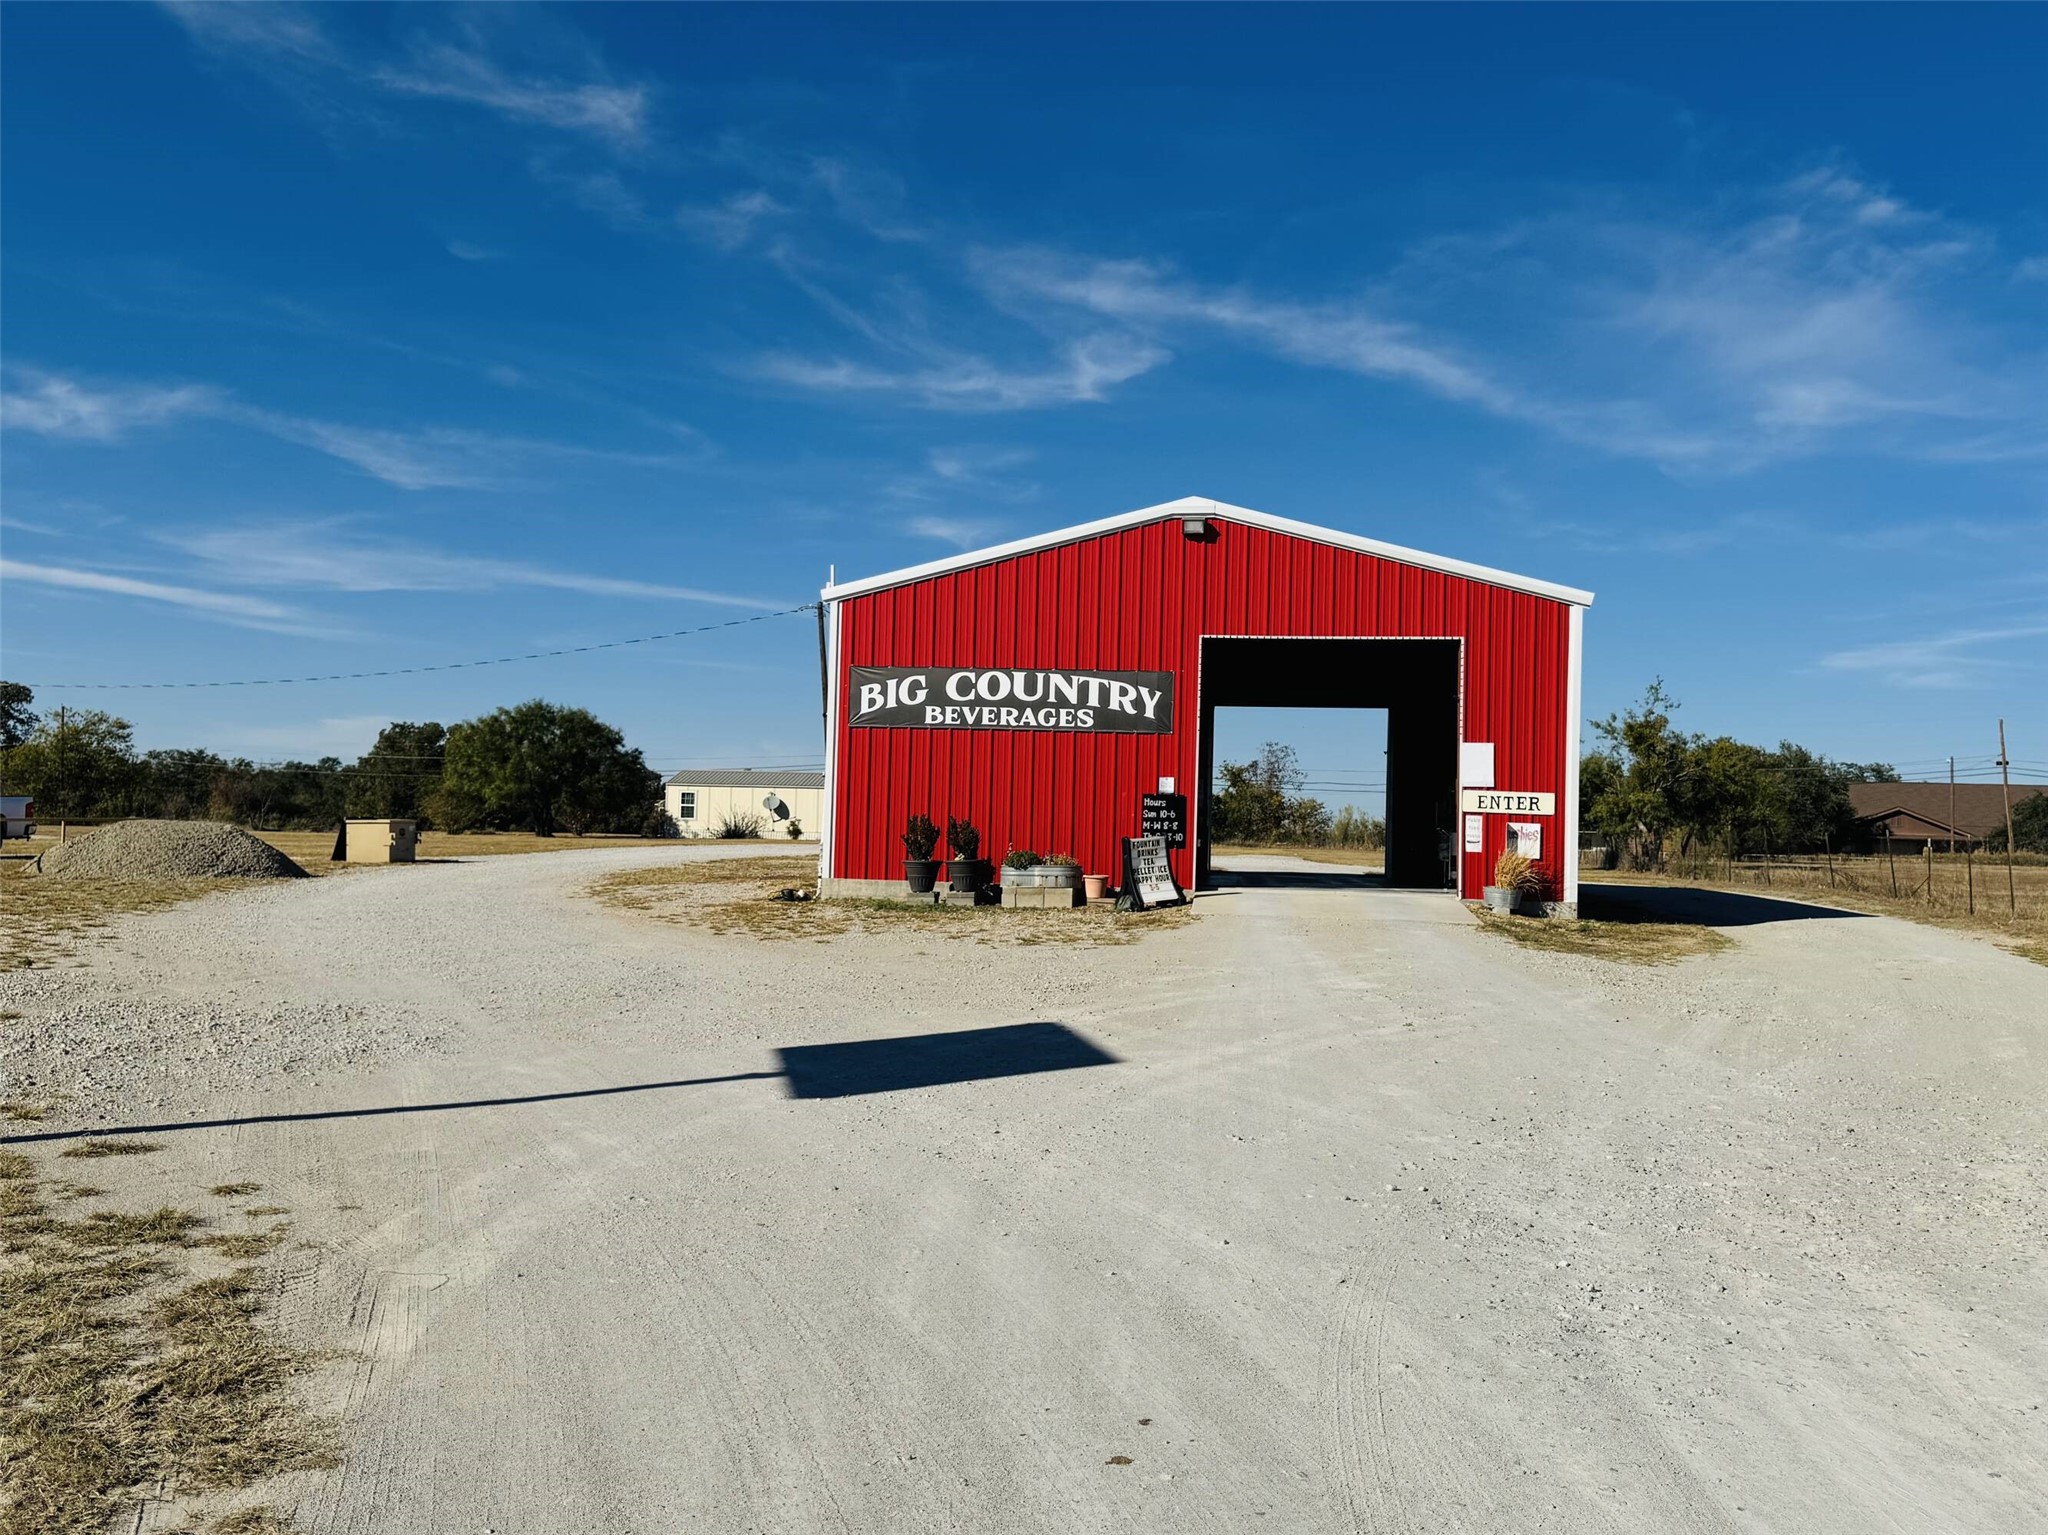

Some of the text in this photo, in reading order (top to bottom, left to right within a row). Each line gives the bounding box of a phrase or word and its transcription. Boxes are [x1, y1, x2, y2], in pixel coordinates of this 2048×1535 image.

[859, 671, 1162, 720] BIG COUNTRY
[924, 706, 1095, 728] BEVERAGES
[1143, 797, 1166, 807] Hours
[1477, 795, 1541, 811] ENTER
[1142, 809, 1176, 819] Sun 10-6
[1132, 839, 1161, 849] FOUNTAIN
[1137, 848, 1159, 858] DRINKS
